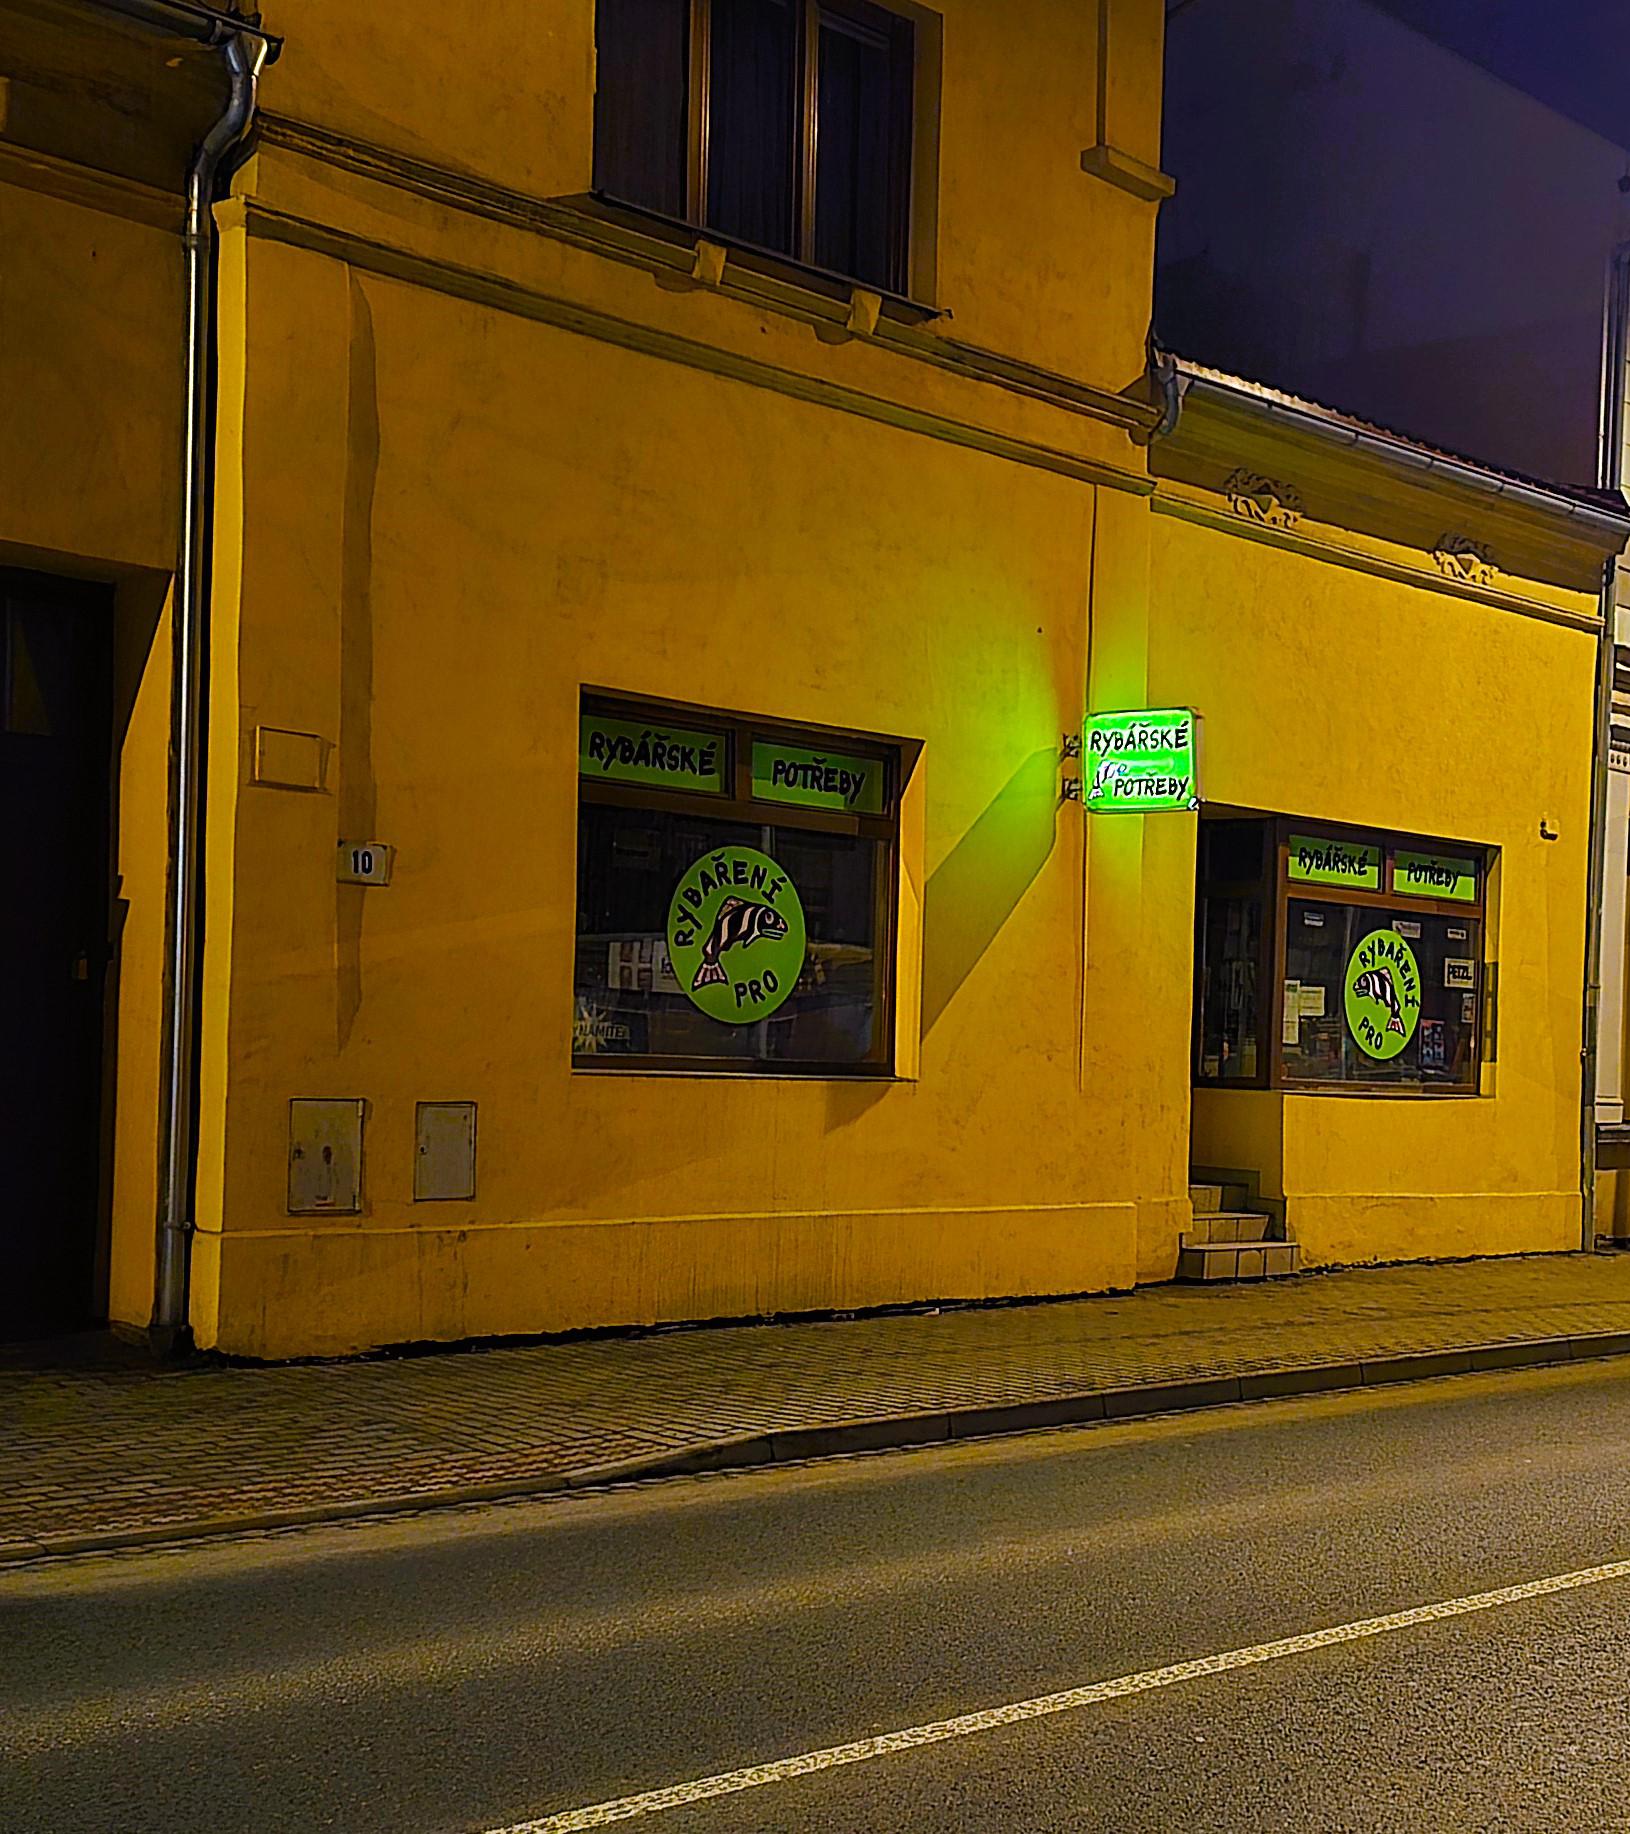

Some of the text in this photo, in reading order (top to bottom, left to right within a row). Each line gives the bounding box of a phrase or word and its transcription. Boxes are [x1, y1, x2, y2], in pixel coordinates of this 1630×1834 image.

[589, 730, 717, 776] RYBÁŘSKÉ
[1090, 720, 1189, 757] RYBÁŘSKÉ
[772, 756, 865, 804] POTŘEBY
[1113, 771, 1189, 800] POTŘEBY
[352, 850, 373, 874] 10
[1298, 844, 1369, 876] RYBÁŘSKÉ
[1407, 859, 1461, 894] POTŘEBY
[674, 852, 788, 947] RYBAŘENÍ
[733, 969, 779, 1009] PRO
[1359, 937, 1420, 1008] RYBAŘENÍ
[1358, 1016, 1383, 1050] PRO
